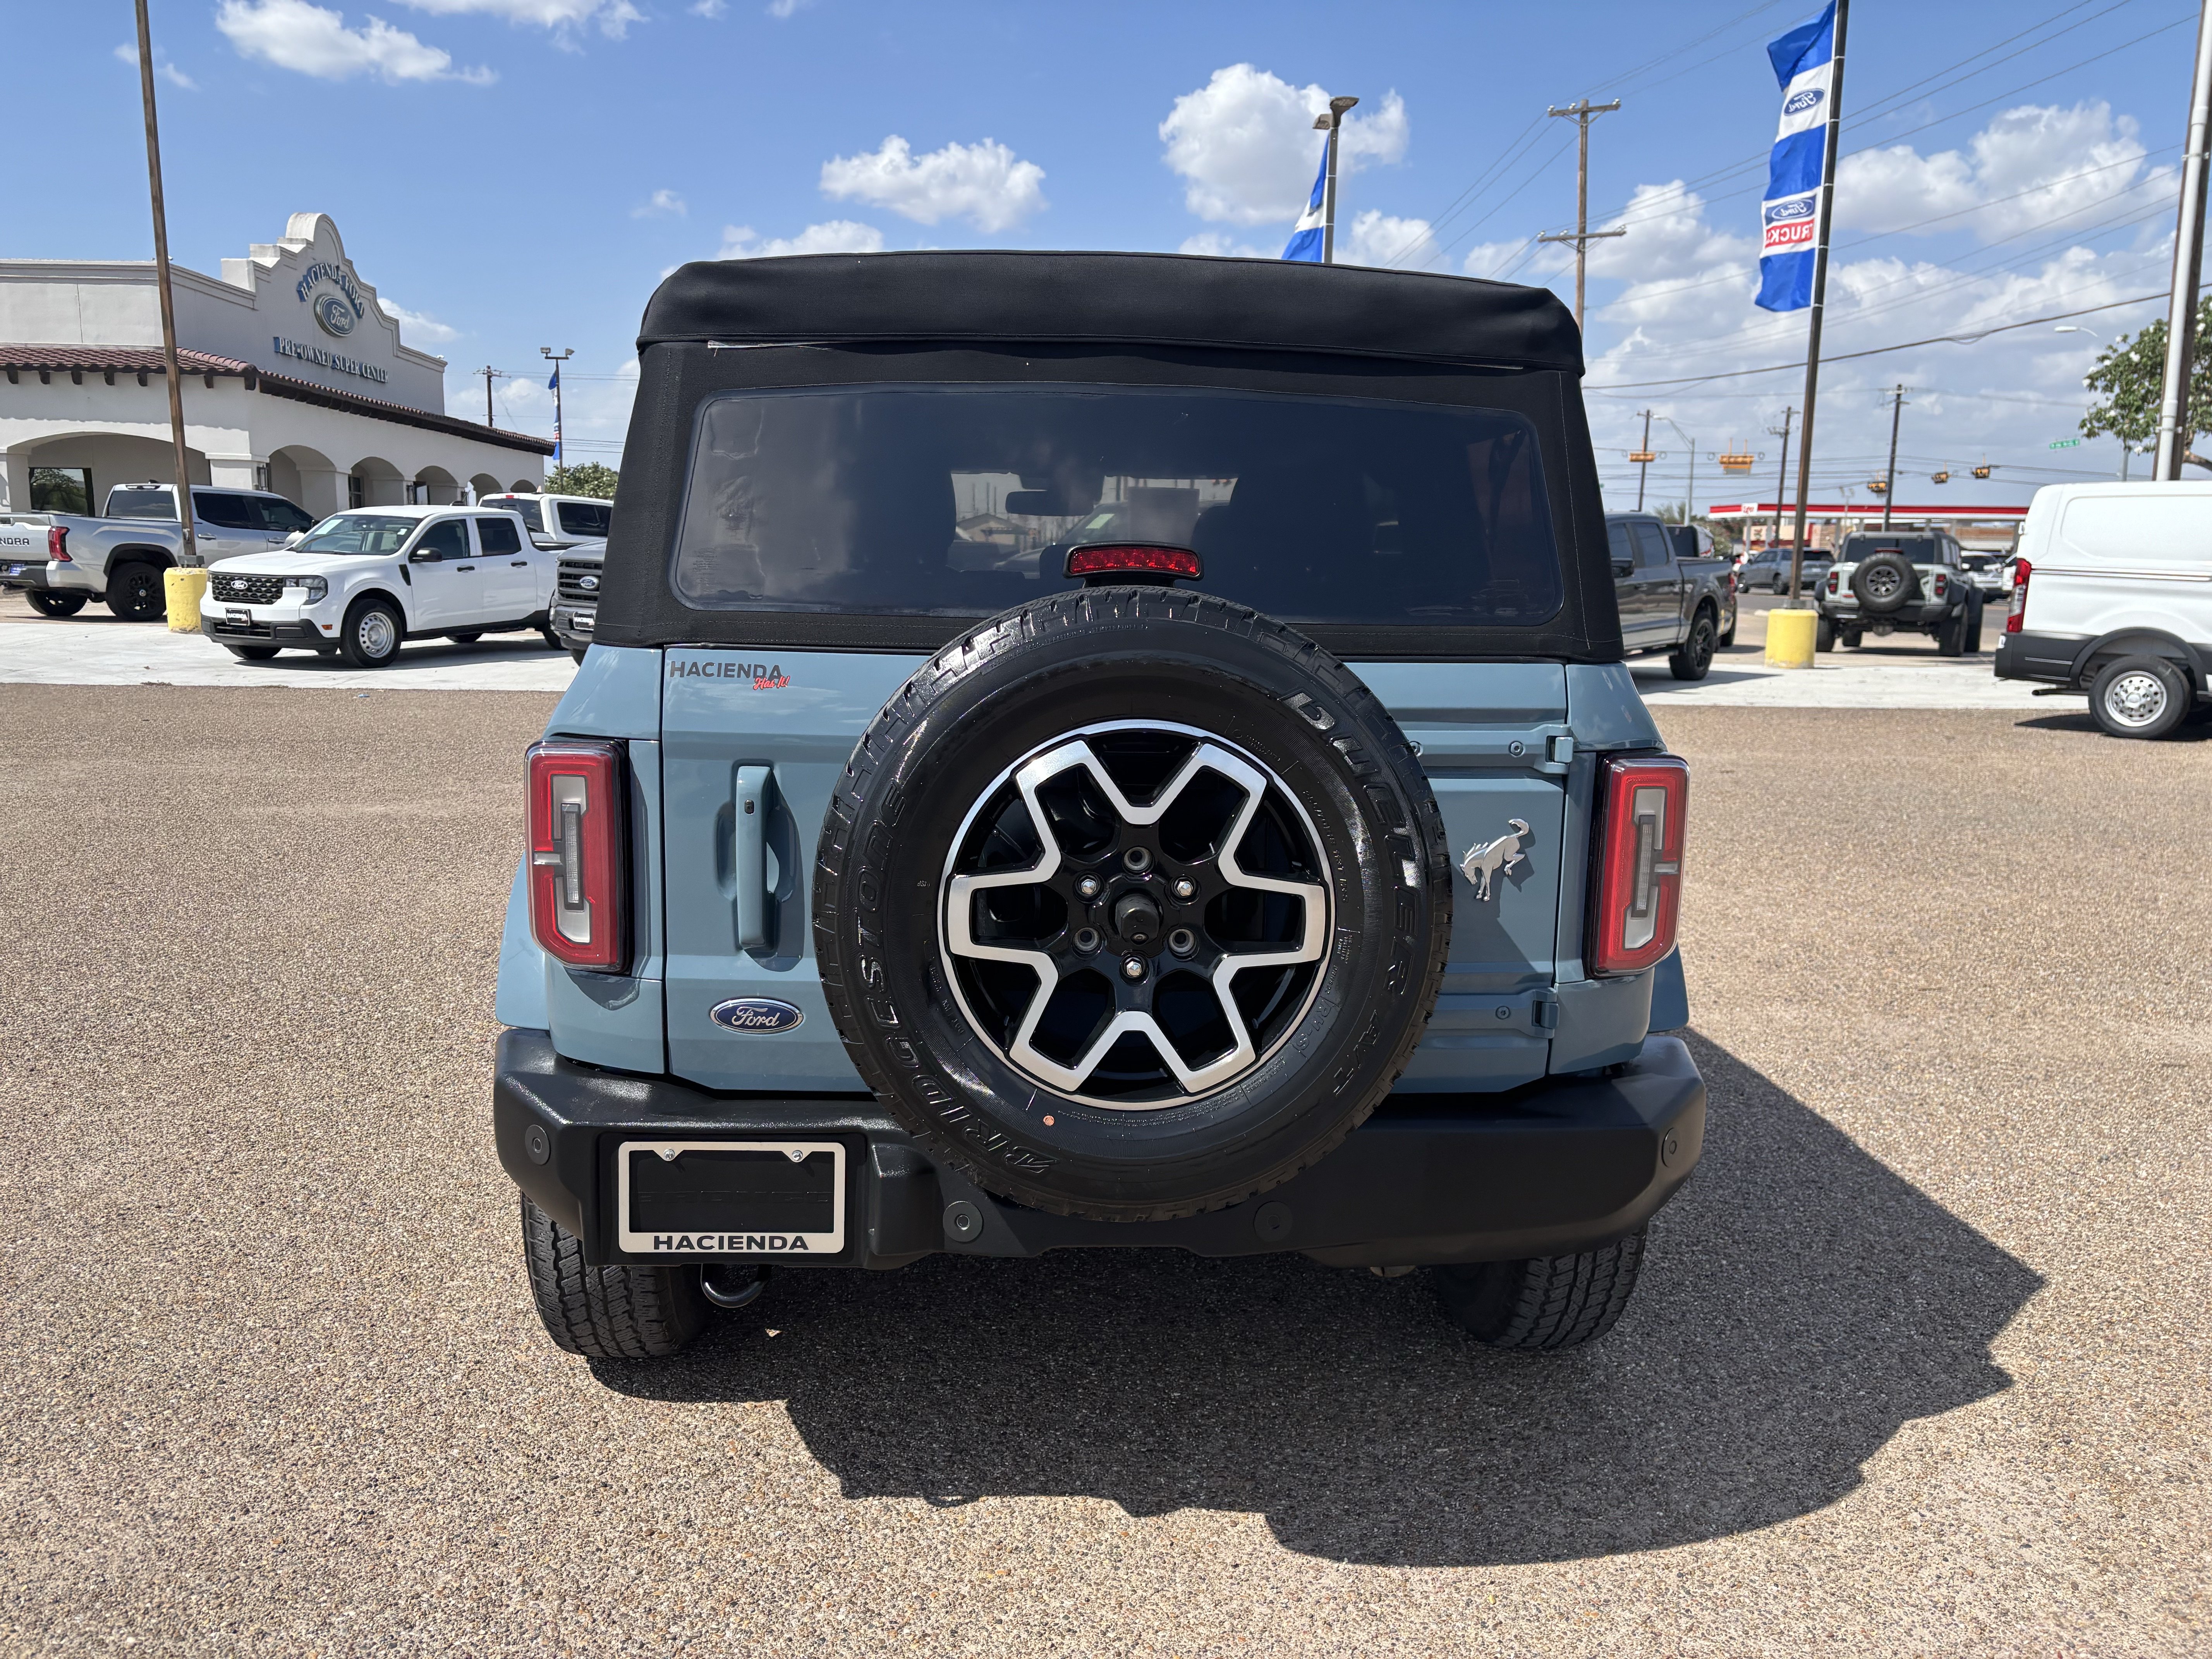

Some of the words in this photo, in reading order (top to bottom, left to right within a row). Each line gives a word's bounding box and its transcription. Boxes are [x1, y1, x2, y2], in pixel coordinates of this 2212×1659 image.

[300, 263, 342, 301] HACIENDA
[330, 304, 350, 329] Ford
[277, 337, 332, 367] PRE-OWNED
[335, 355, 360, 375] SUPER
[362, 363, 388, 383] CENTER
[670, 661, 783, 680] HACIENDA
[753, 677, 775, 690] Has
[776, 675, 790, 689] It!
[1279, 691, 1419, 996] DUELER
[856, 778, 1057, 1174] BRIDGESTONE
[731, 1006, 780, 1027] Ford
[653, 1235, 809, 1251] HACIENDA
